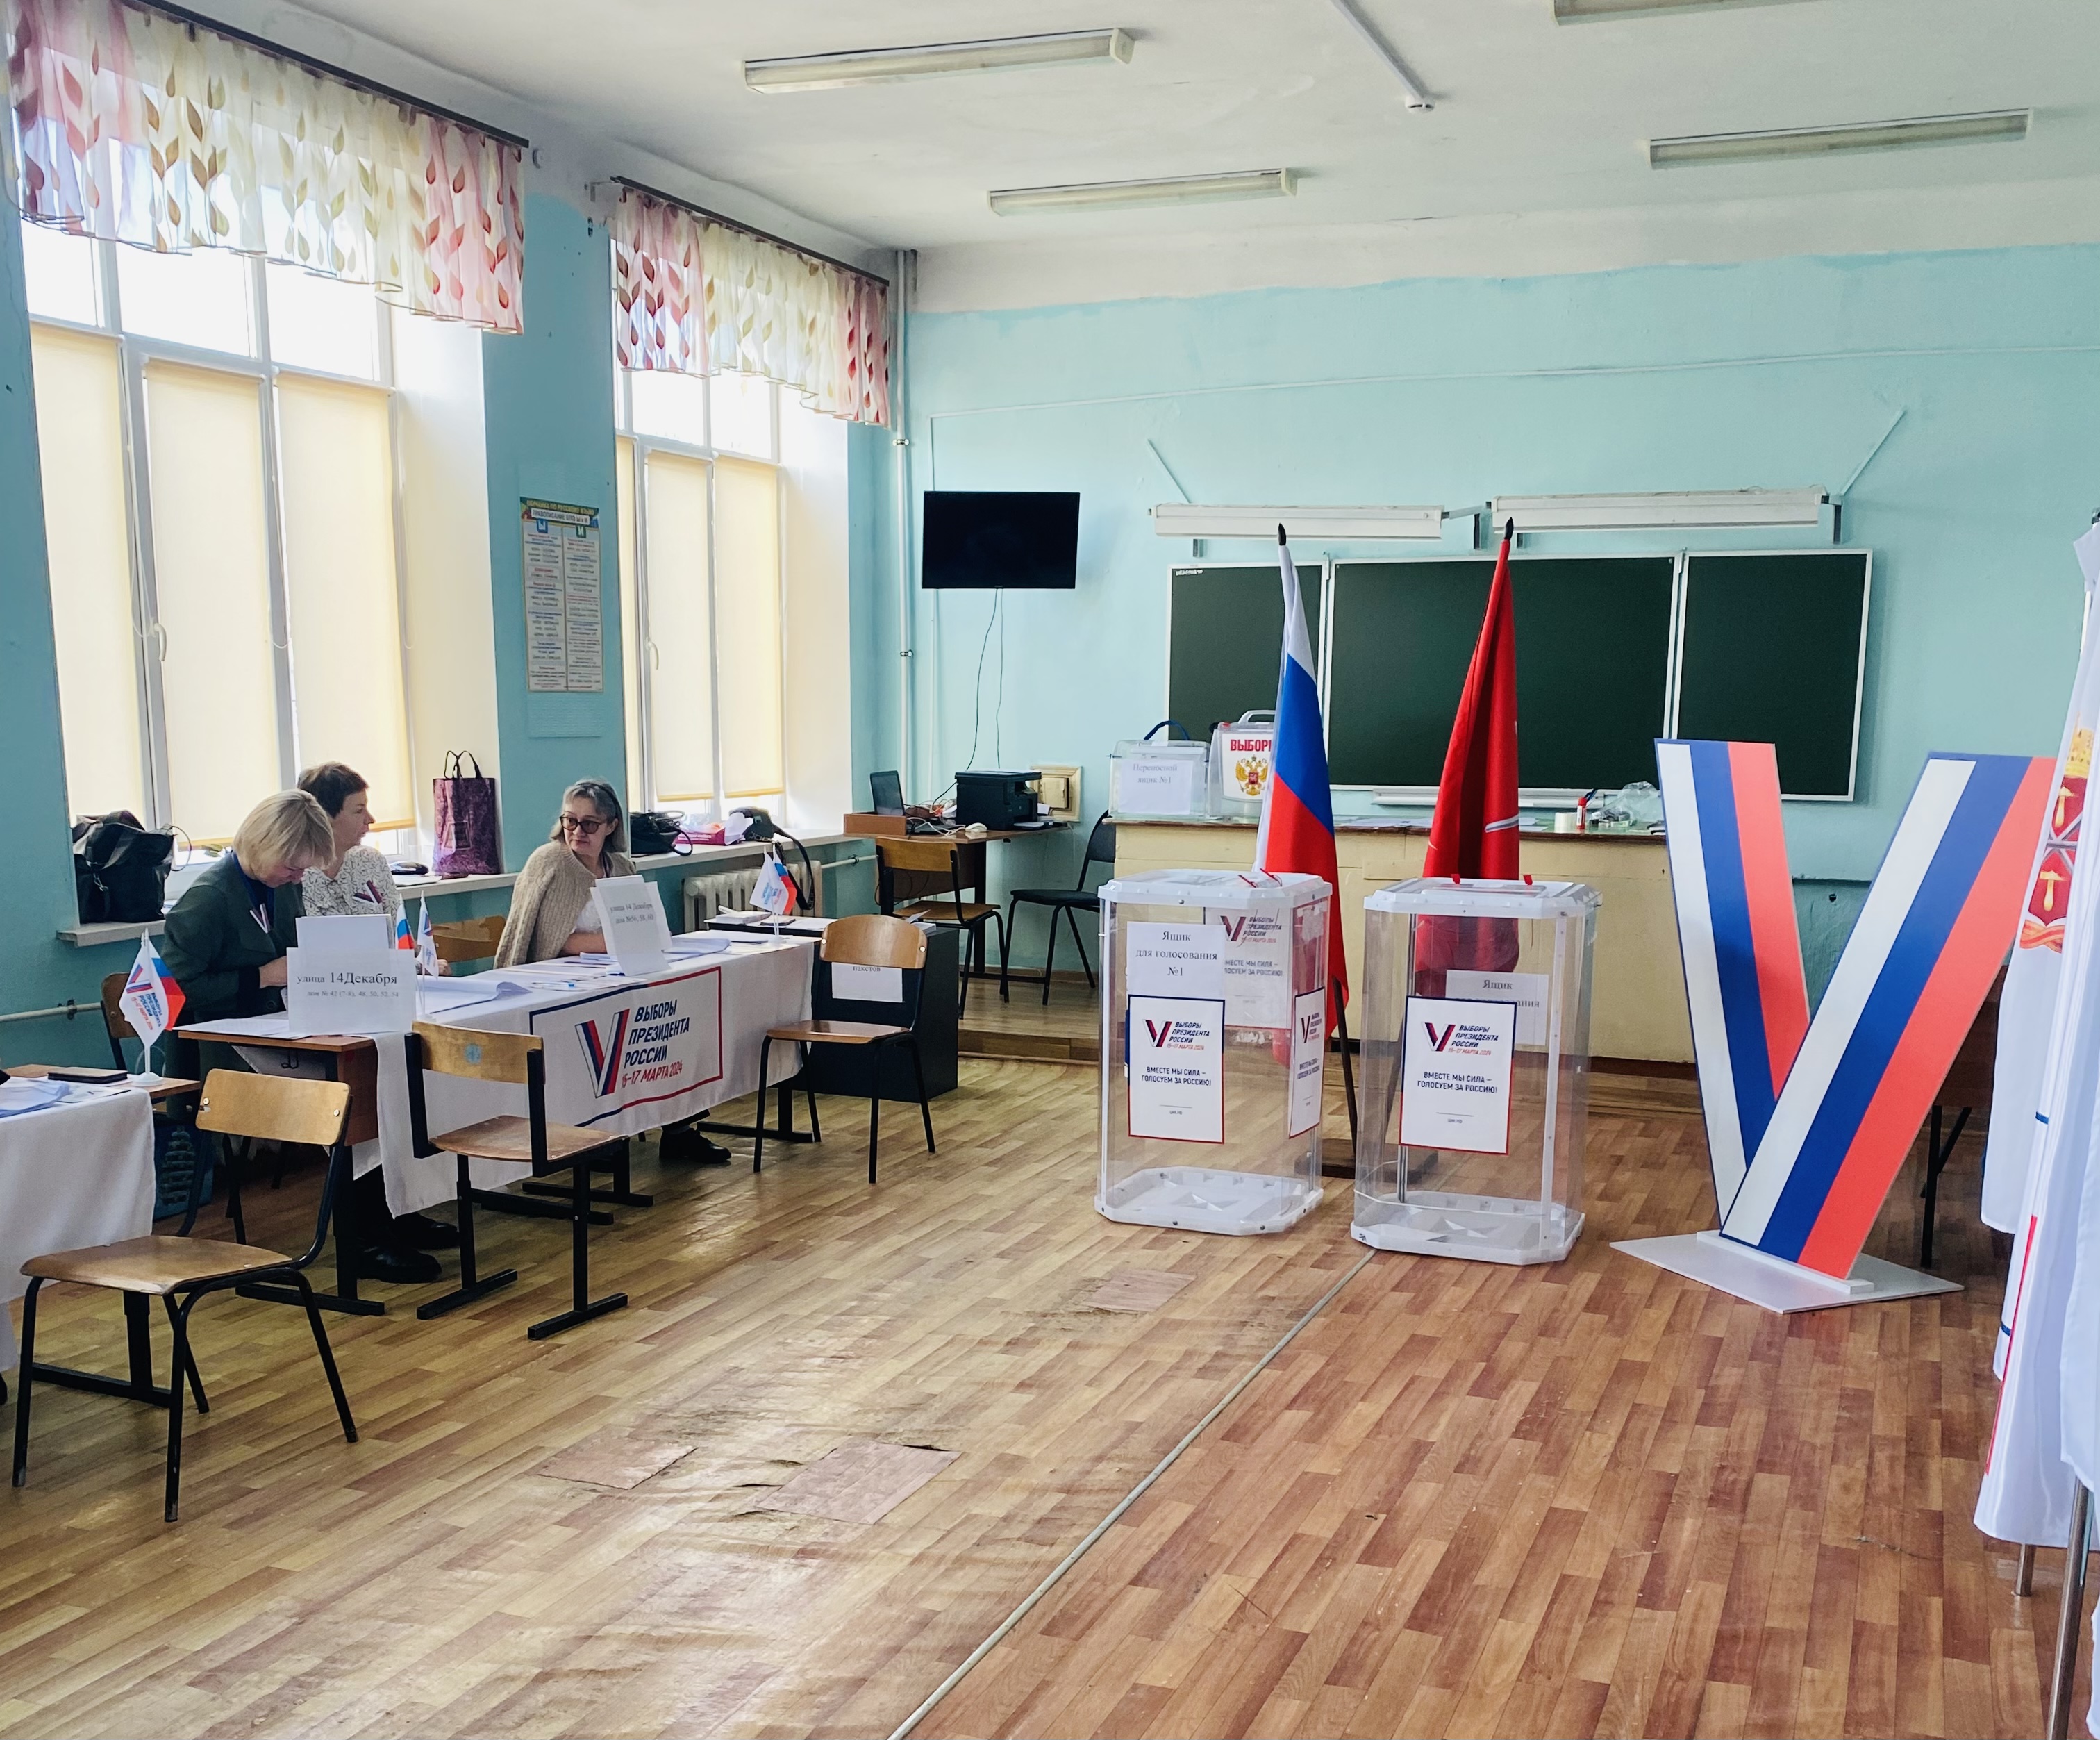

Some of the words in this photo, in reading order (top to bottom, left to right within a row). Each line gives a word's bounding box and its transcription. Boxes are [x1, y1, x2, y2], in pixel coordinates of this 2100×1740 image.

[1133, 763, 1178, 774] Переносной
[1138, 775, 1158, 784] ящик
[1162, 931, 1191, 941] Ящик
[1156, 950, 1217, 960] голосования
[1167, 966, 1183, 976] №1
[297, 975, 325, 985] улица
[1483, 979, 1512, 990] Ящик
[138, 995, 153, 1017] РОССИИ
[635, 1000, 678, 1022] ВЫБОРЫ
[628, 1017, 690, 1045] ПРЕЗИДЕНТА
[1172, 1029, 1210, 1037] ПРЕЗИДЕНТА
[1455, 1033, 1499, 1041] ПРЕЗИДЕНТА
[624, 1045, 668, 1068] РОССИИ
[640, 1065, 669, 1083] МАРТА
[669, 1060, 683, 1077] 2024
[1147, 1066, 1169, 1075] ВМЕСТЕ
[1424, 1071, 1450, 1080] ВМЕСТЕ
[1141, 1075, 1173, 1083] ГОЛОСУЕМ
[1417, 1080, 1453, 1090] ГОЛОСУЕМ
